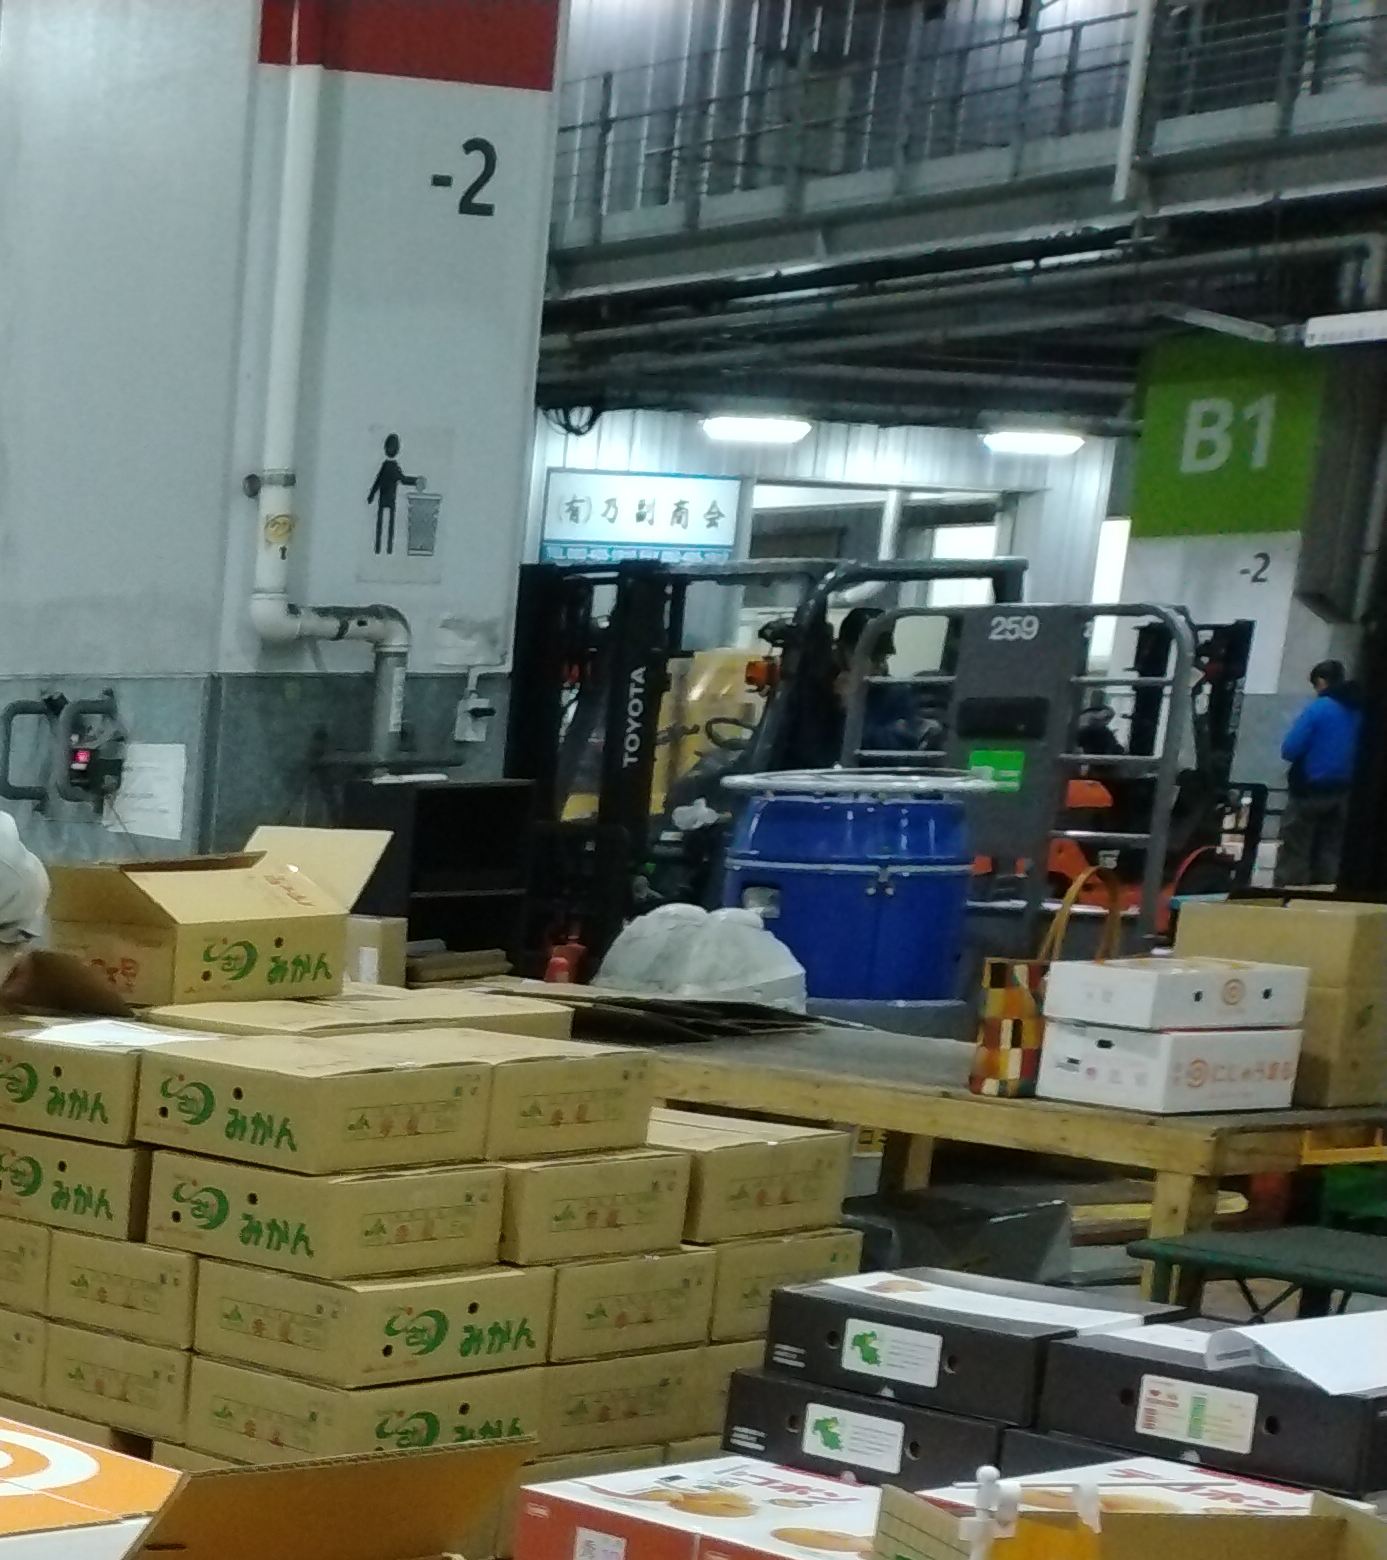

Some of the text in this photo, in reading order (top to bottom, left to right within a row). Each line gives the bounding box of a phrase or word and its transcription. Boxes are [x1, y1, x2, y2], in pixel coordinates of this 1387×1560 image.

[431, 137, 498, 217] -2
[1180, 393, 1276, 474] B1
[1239, 552, 1271, 583] -2
[988, 616, 1039, 642] 259
[622, 666, 647, 768] TOYOTA
[269, 949, 332, 985] みかん
[47, 1086, 108, 1124] みかん
[226, 1108, 296, 1153] みかん
[50, 1179, 112, 1220] みかん
[239, 1213, 313, 1258] みかん
[458, 1319, 536, 1358] みかん
